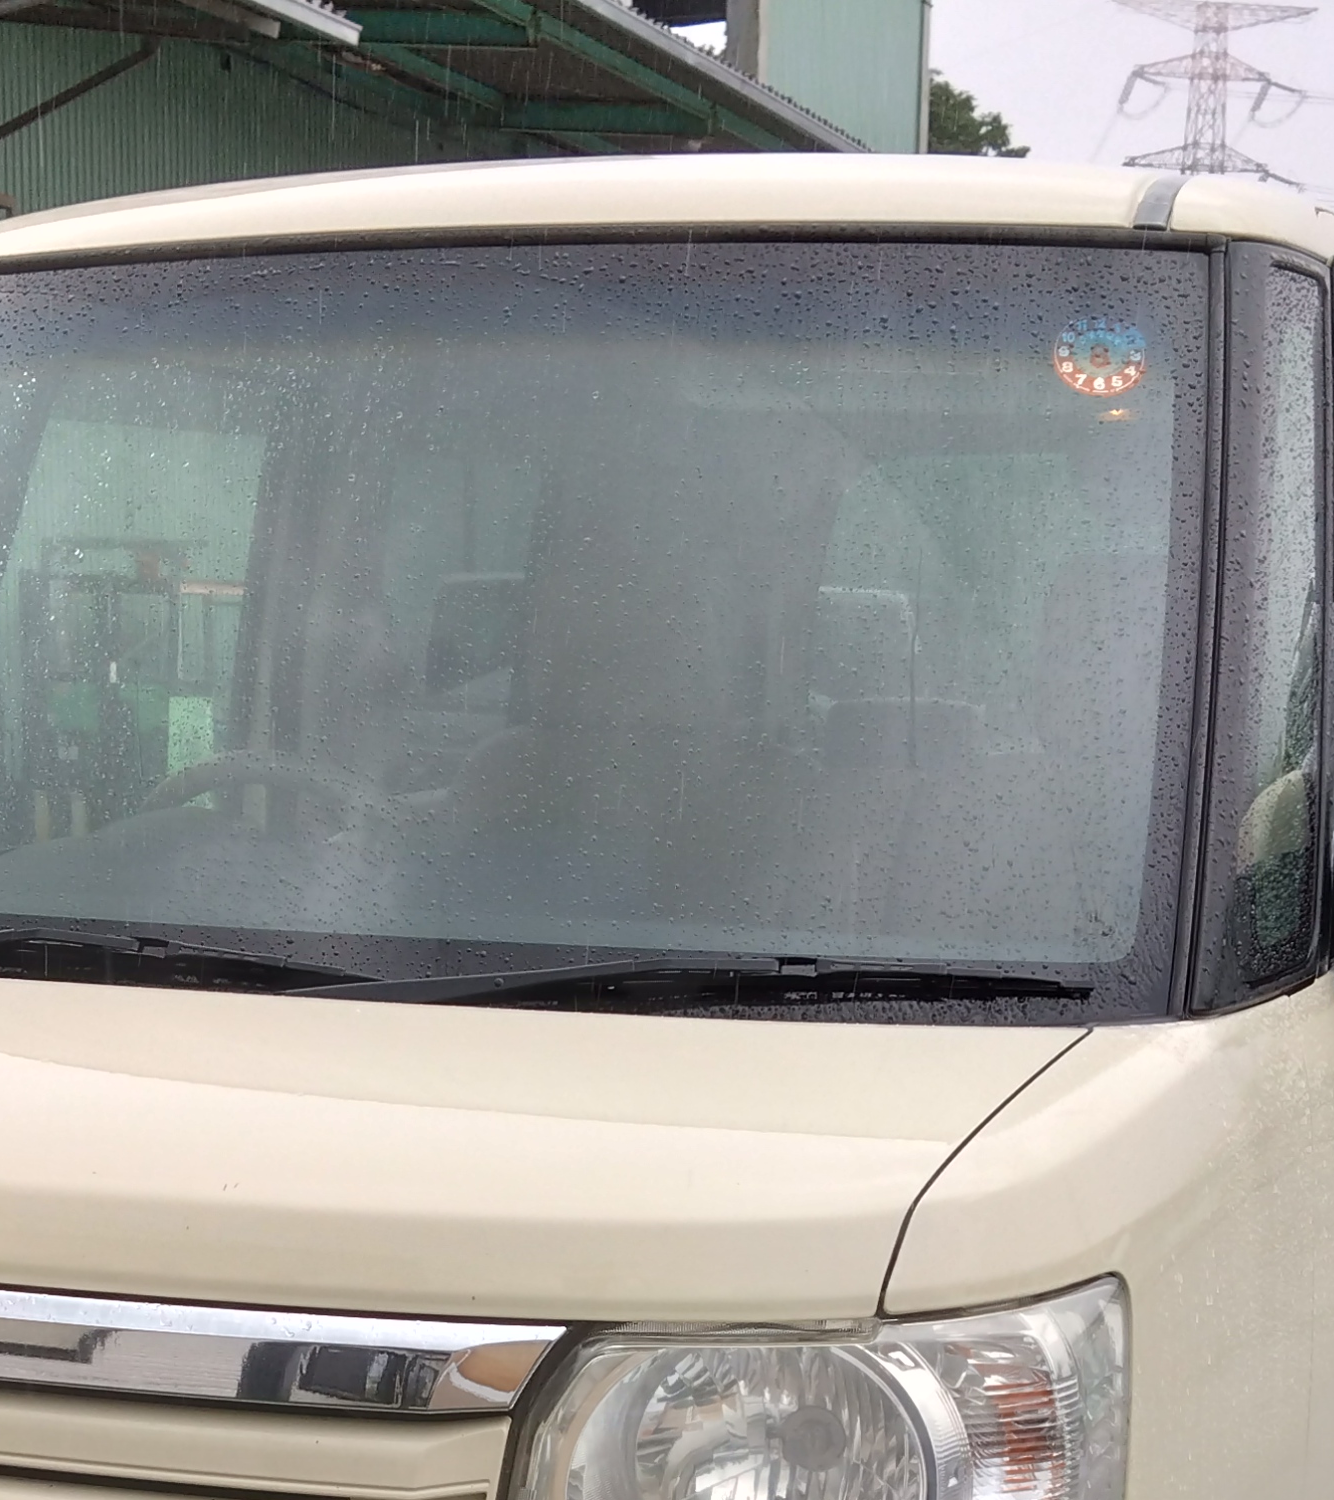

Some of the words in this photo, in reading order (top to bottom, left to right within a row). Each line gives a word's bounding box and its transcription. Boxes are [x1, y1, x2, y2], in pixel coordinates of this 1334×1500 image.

[1062, 332, 1075, 343] 10
[1062, 361, 1073, 373] 8
[1123, 365, 1137, 376] 4
[1075, 373, 1088, 385] 7
[1093, 376, 1106, 390] 6
[1111, 375, 1123, 387] 5
